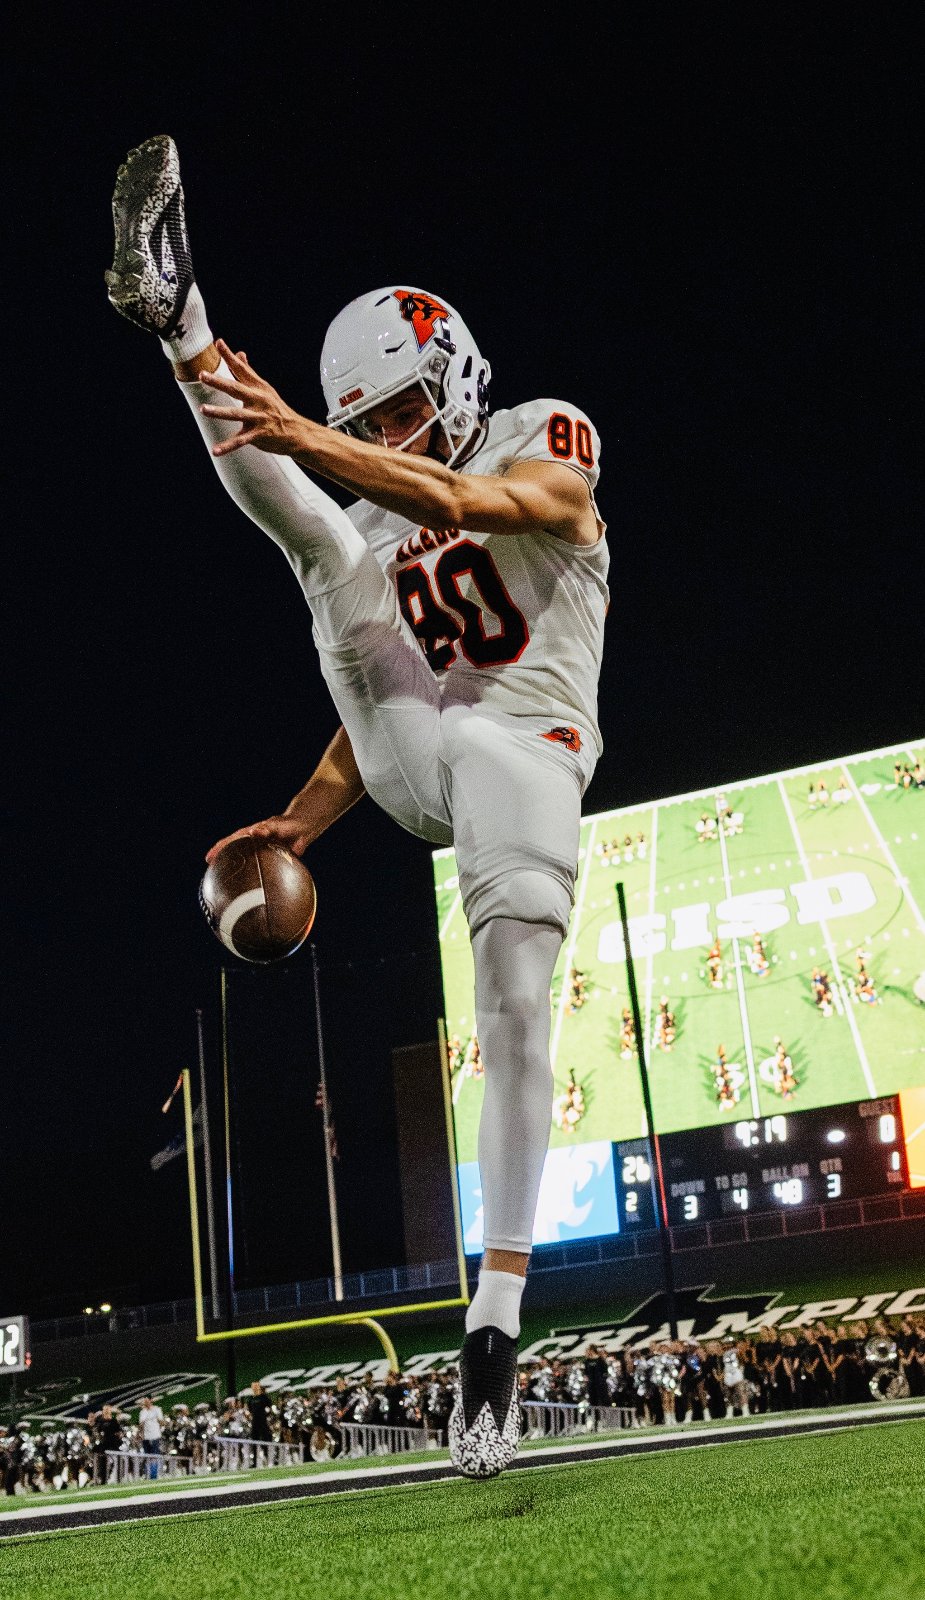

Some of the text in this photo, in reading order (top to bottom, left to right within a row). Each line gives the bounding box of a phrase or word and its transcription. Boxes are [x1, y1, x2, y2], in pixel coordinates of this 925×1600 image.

[547, 412, 594, 469] 80
[396, 539, 530, 669] 80
[622, 1155, 651, 1184] 26
[733, 1188, 749, 1210] 4
[827, 1173, 842, 1198] 3
[625, 1191, 638, 1212] 2
[684, 1195, 698, 1220] 3
[0, 1324, 20, 1366] 2
